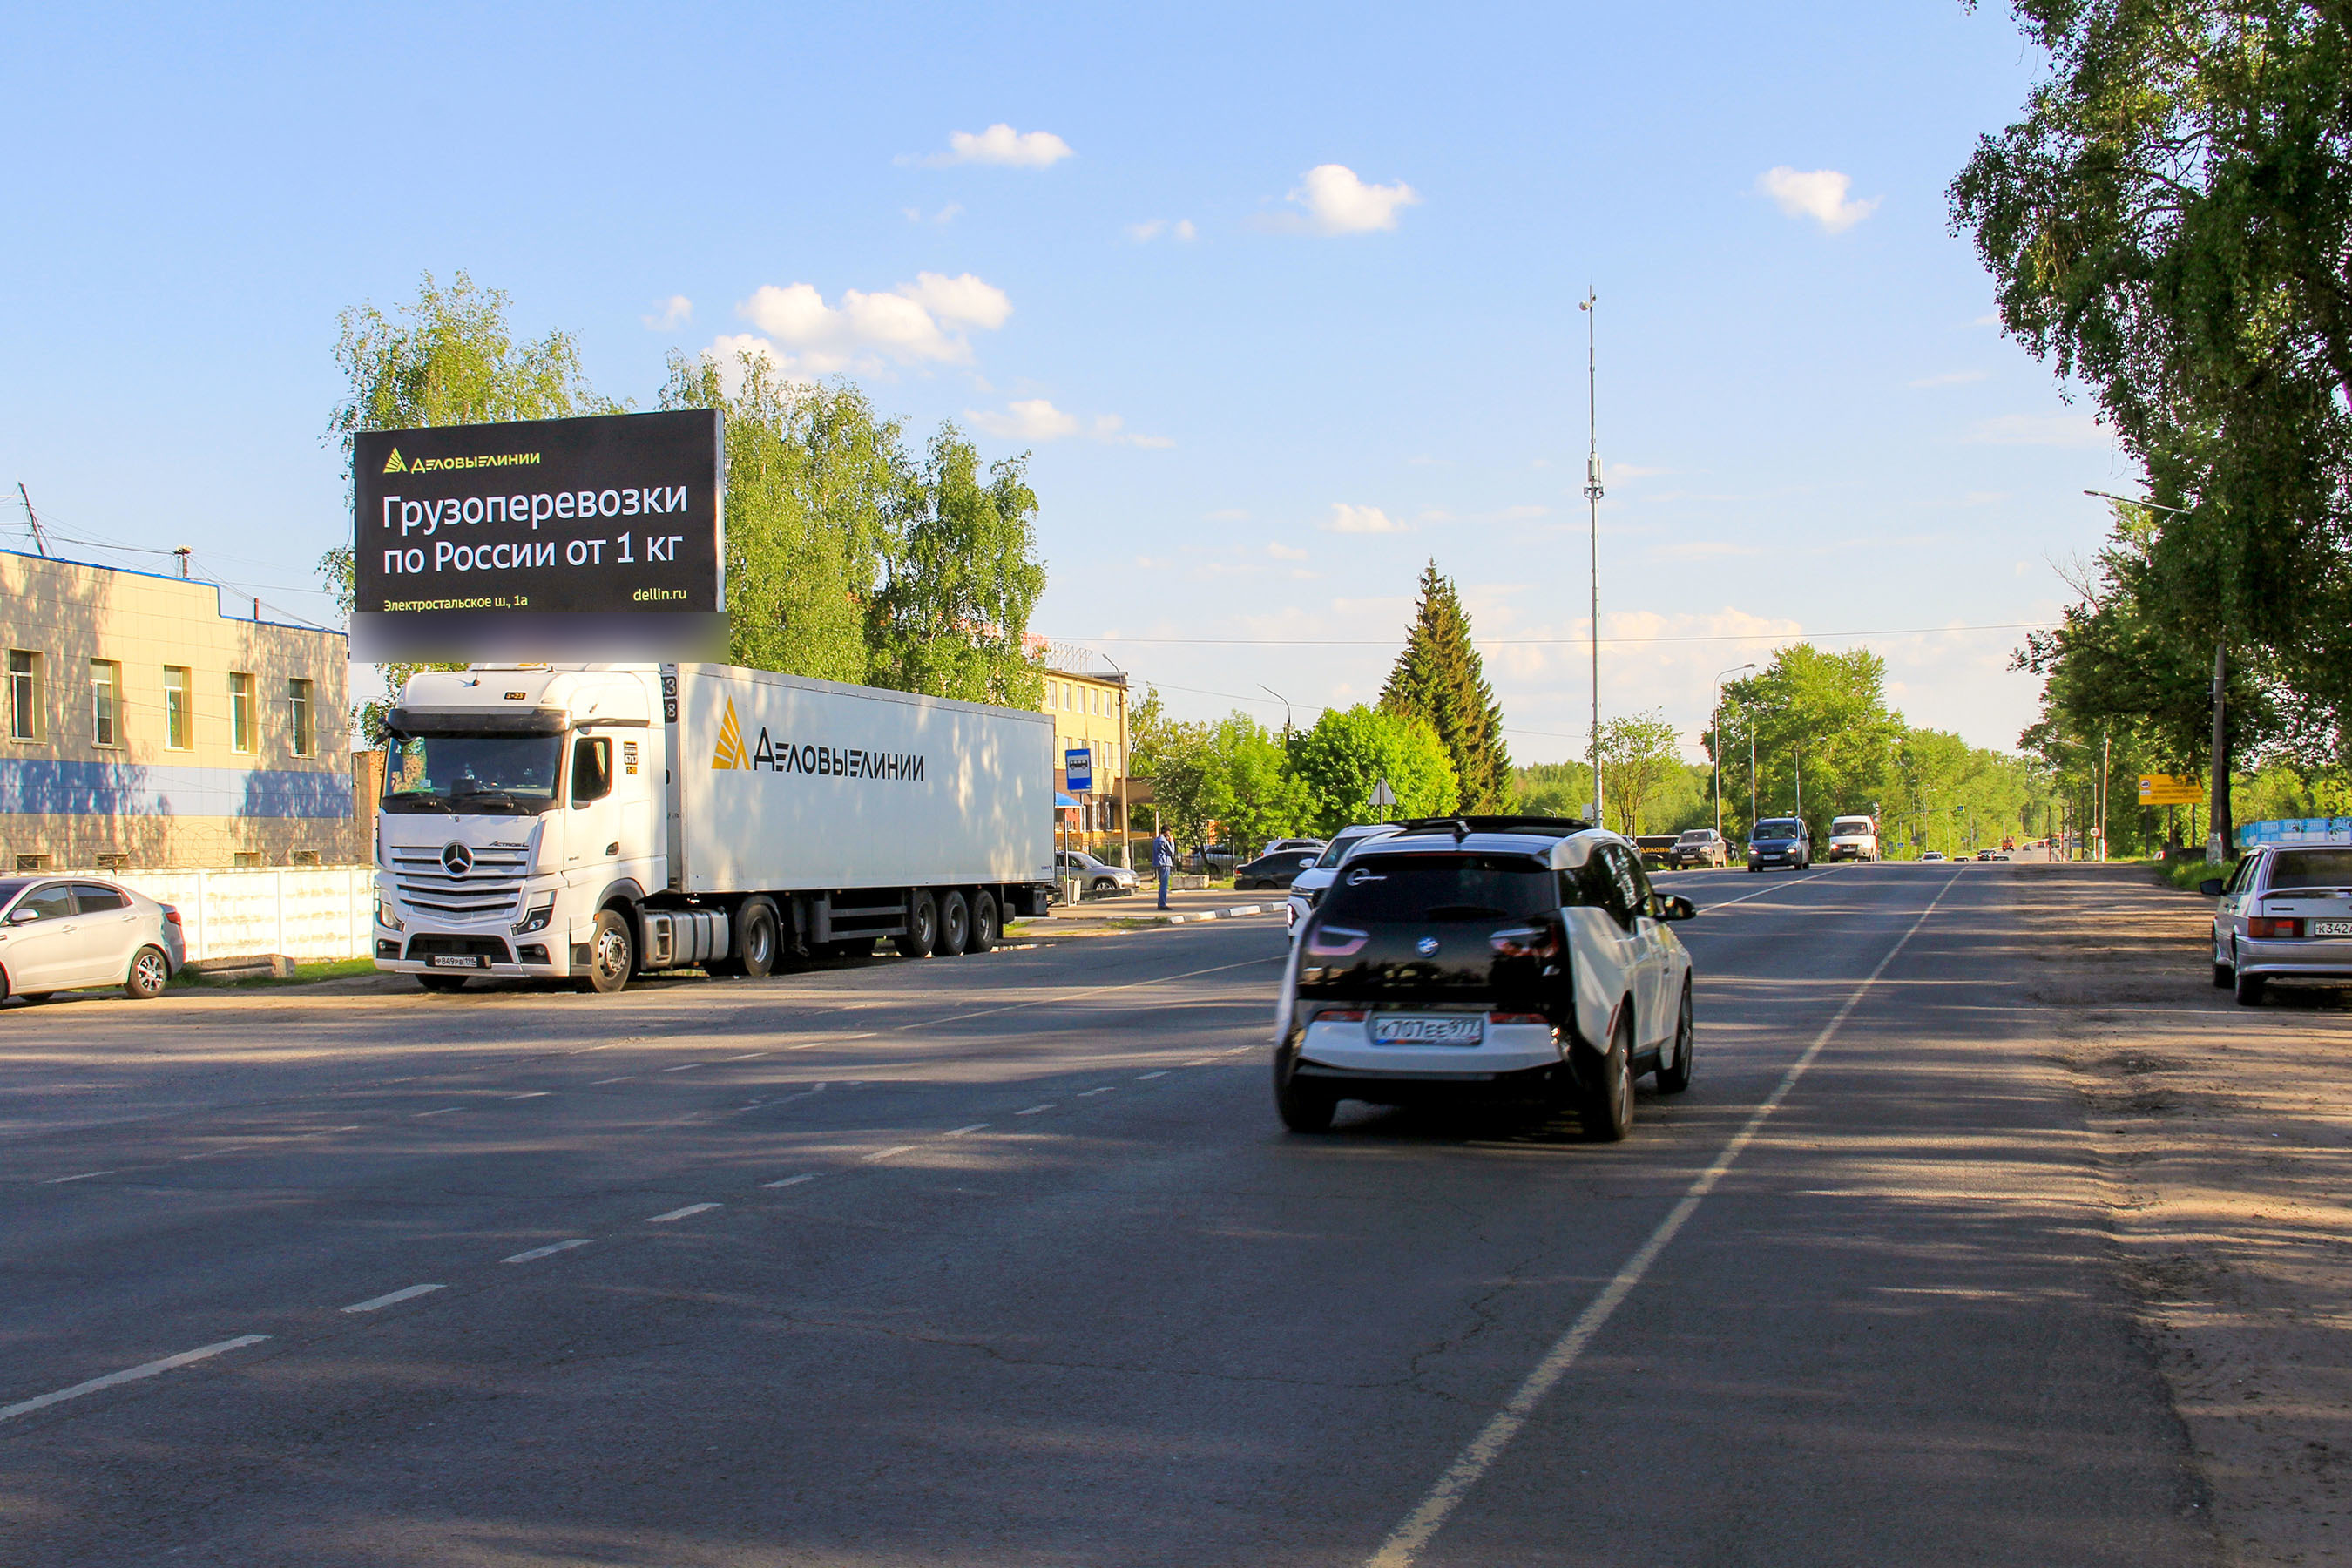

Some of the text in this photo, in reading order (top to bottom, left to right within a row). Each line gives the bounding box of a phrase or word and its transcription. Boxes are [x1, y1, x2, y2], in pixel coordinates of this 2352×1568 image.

[383, 485, 688, 537] Грузоперевозки
[383, 531, 684, 575] по России от 1 кг
[383, 594, 529, 613] Электростальское ш., 1а
[632, 587, 688, 602] dellin.ru
